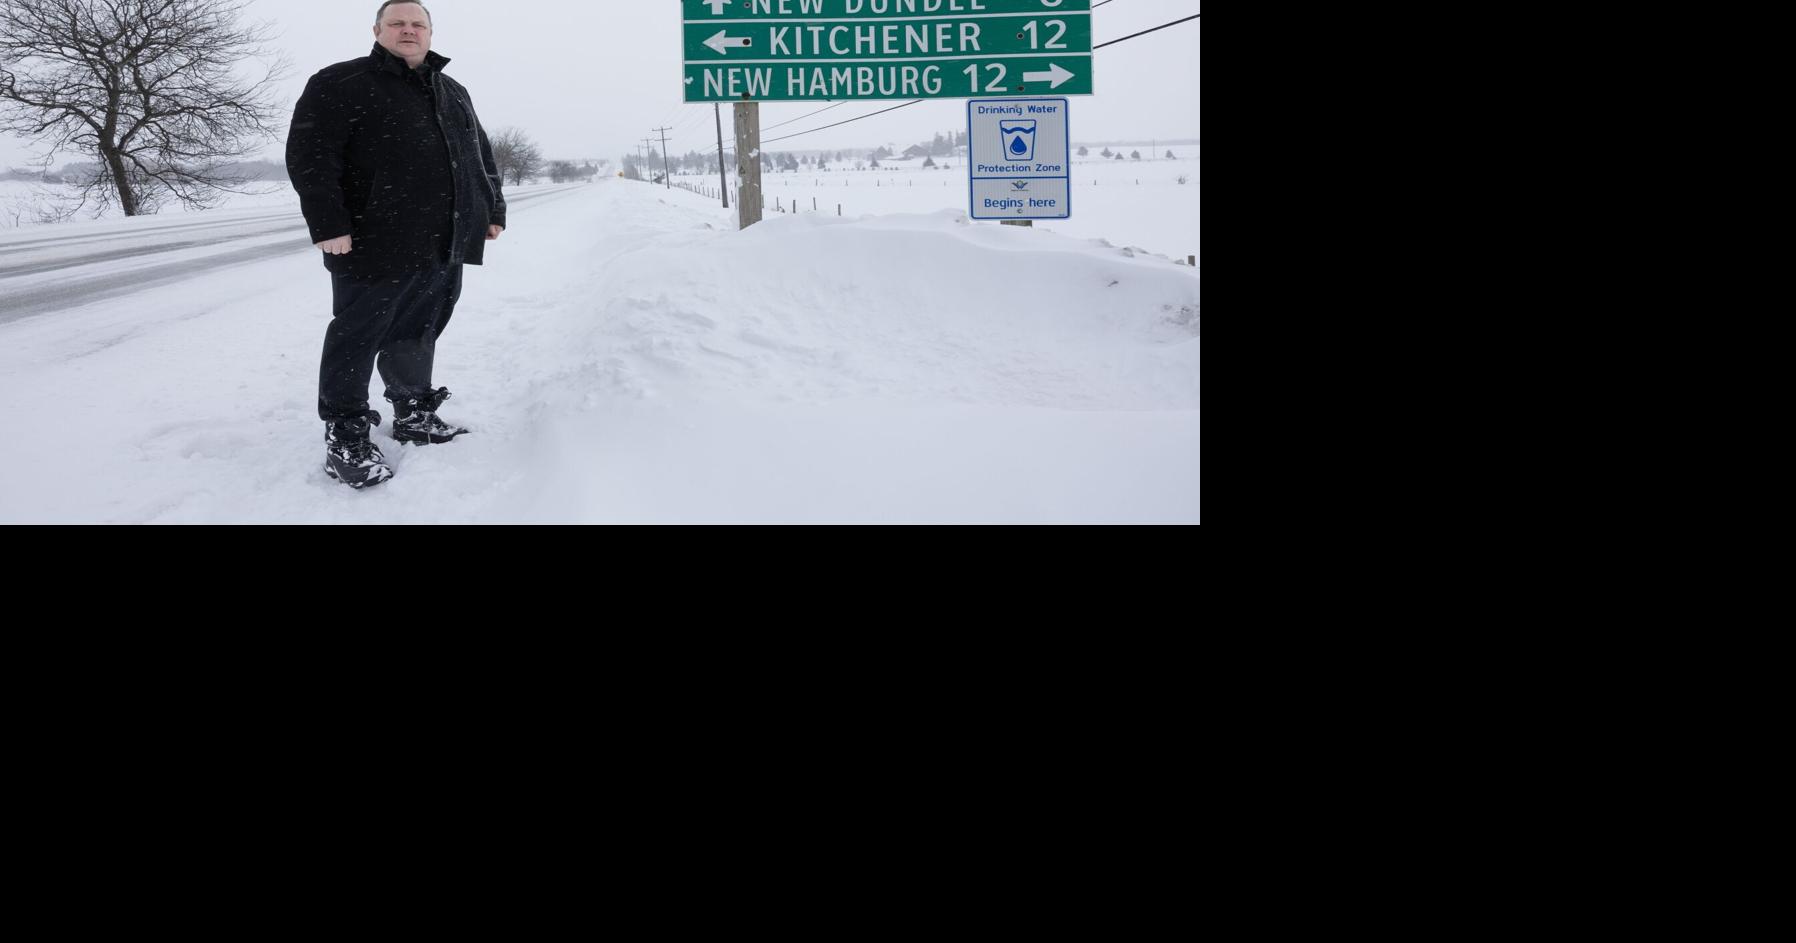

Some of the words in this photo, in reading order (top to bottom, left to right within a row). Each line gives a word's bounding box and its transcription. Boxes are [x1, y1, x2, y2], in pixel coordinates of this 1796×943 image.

[769, 23, 982, 55] KITCHENER
[1022, 19, 1068, 49] 12
[703, 67, 772, 97] NEW
[787, 65, 943, 96] HAMBURG
[962, 63, 1008, 93] 12
[978, 105, 1022, 115] Drinking
[1027, 105, 1057, 113] Water
[977, 164, 1031, 172] Protection
[1035, 163, 1061, 172] Zone
[984, 197, 1024, 210] Begins
[1029, 197, 1056, 208] here
